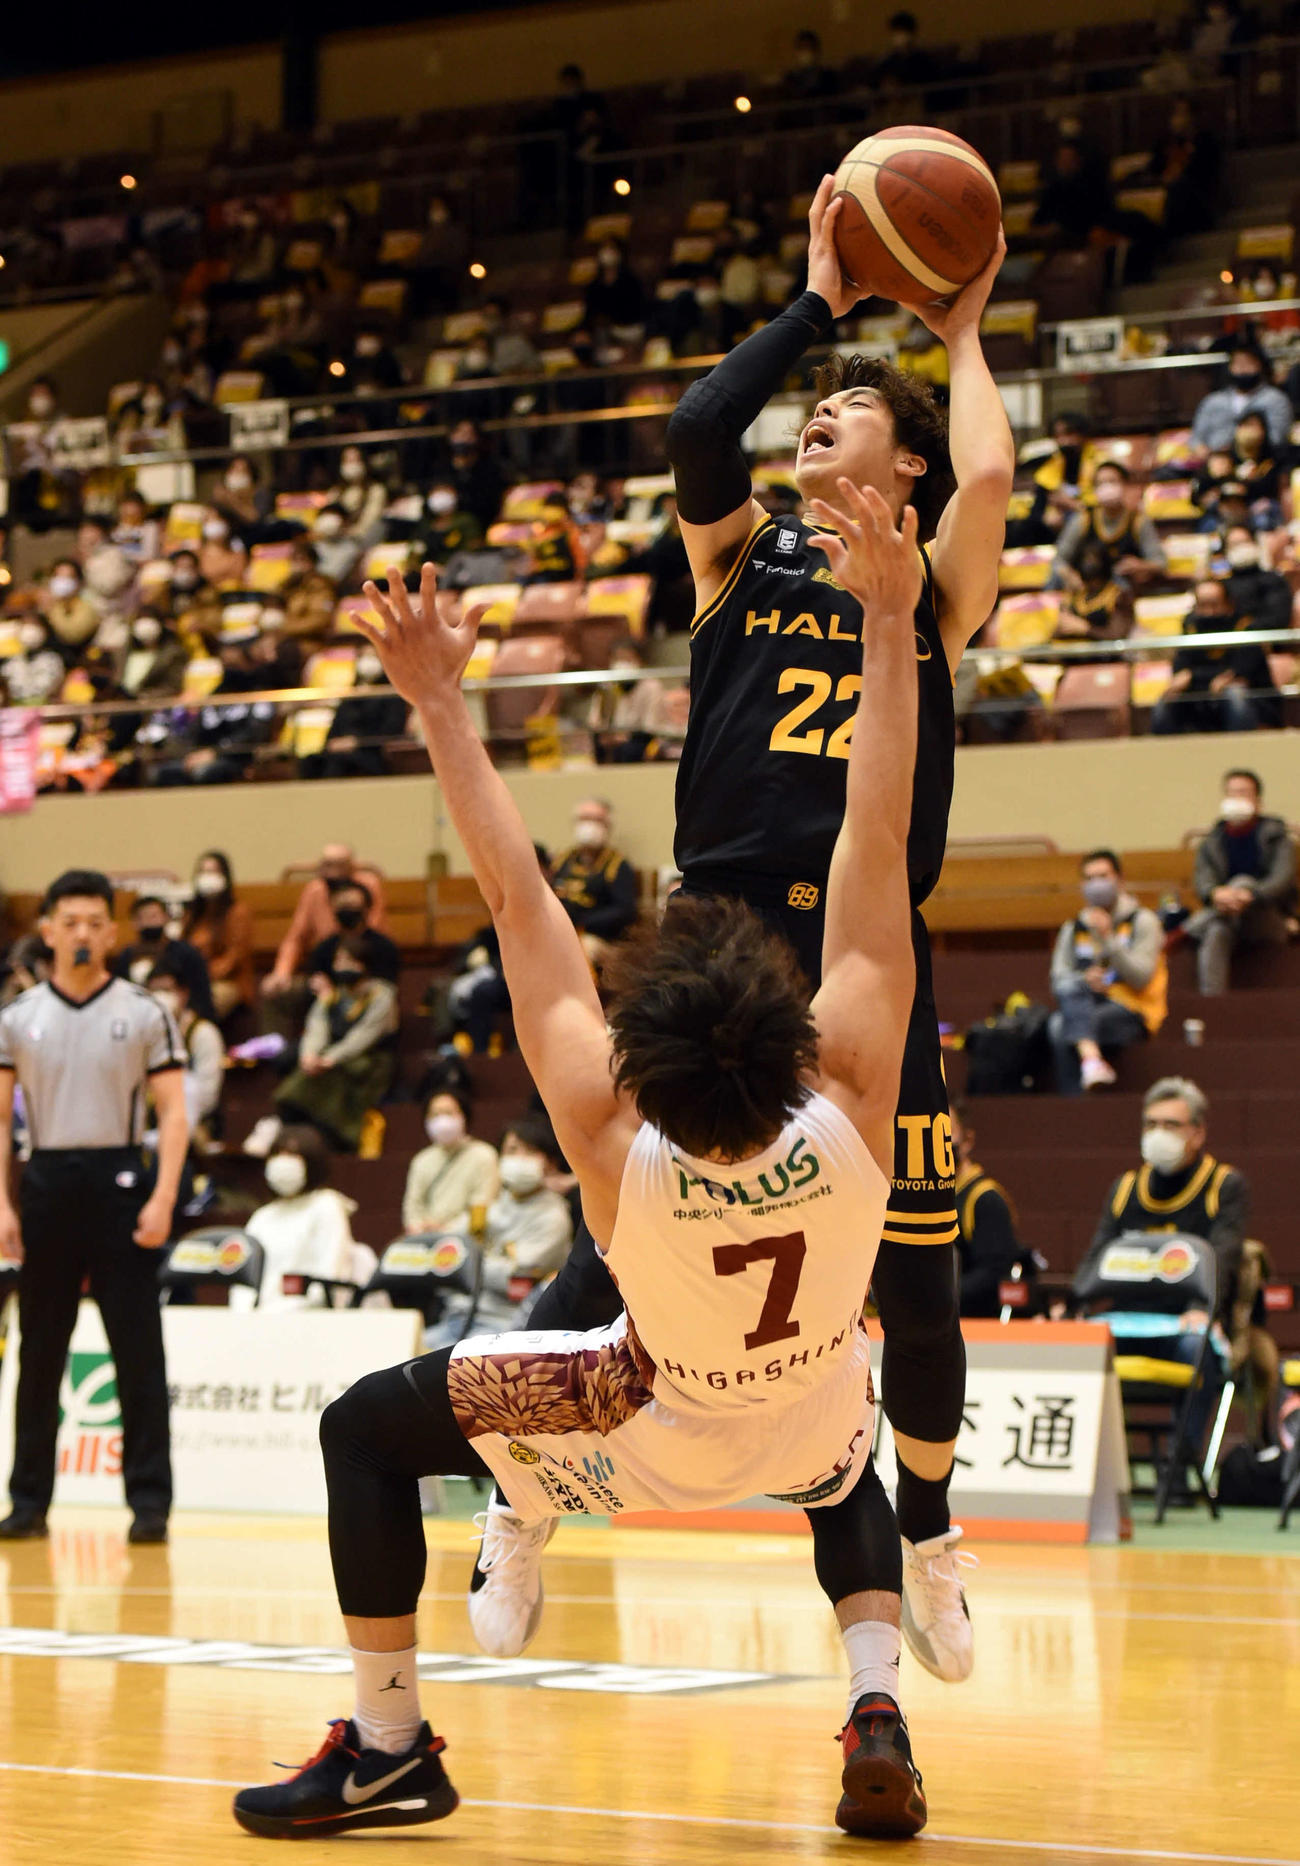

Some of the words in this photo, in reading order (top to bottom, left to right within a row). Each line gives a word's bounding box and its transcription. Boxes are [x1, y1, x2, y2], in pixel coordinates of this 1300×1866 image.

[766, 565, 806, 576] Fanatics
[787, 885, 819, 907] 89
[897, 1112, 955, 1179] TG
[892, 1179, 935, 1191] TOYOTA
[712, 1231, 806, 1350] 7
